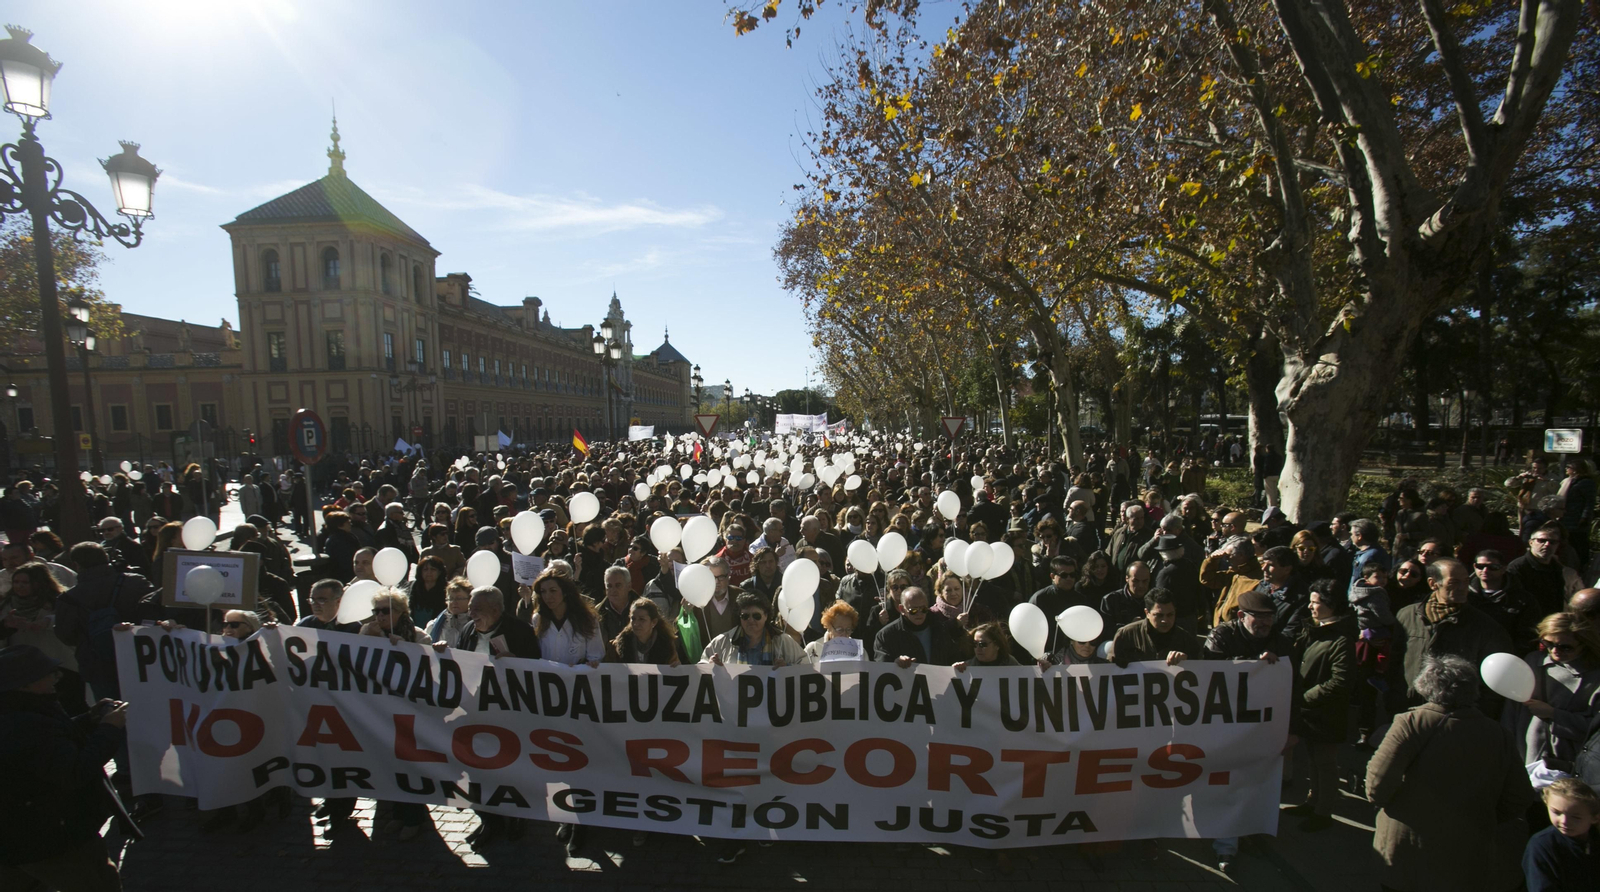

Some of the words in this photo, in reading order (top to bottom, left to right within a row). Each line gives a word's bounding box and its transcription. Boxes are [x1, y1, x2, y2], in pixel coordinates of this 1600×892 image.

[134, 634, 191, 688] POR
[191, 639, 277, 693] UNA
[285, 636, 463, 709] SANIDAD
[478, 666, 723, 724] ANDALUZA
[735, 672, 938, 728] PUBLICA
[951, 677, 986, 729] Y
[1000, 671, 1273, 733] UNIVERSAL.
[169, 698, 265, 758] NO
[297, 704, 363, 752] A
[394, 713, 589, 772] LOS
[625, 736, 1231, 799] RECORTES.
[252, 756, 375, 793] POR
[394, 772, 532, 809] UNA
[552, 788, 850, 831] GESTIÓN
[874, 805, 1099, 839] JUSTA
